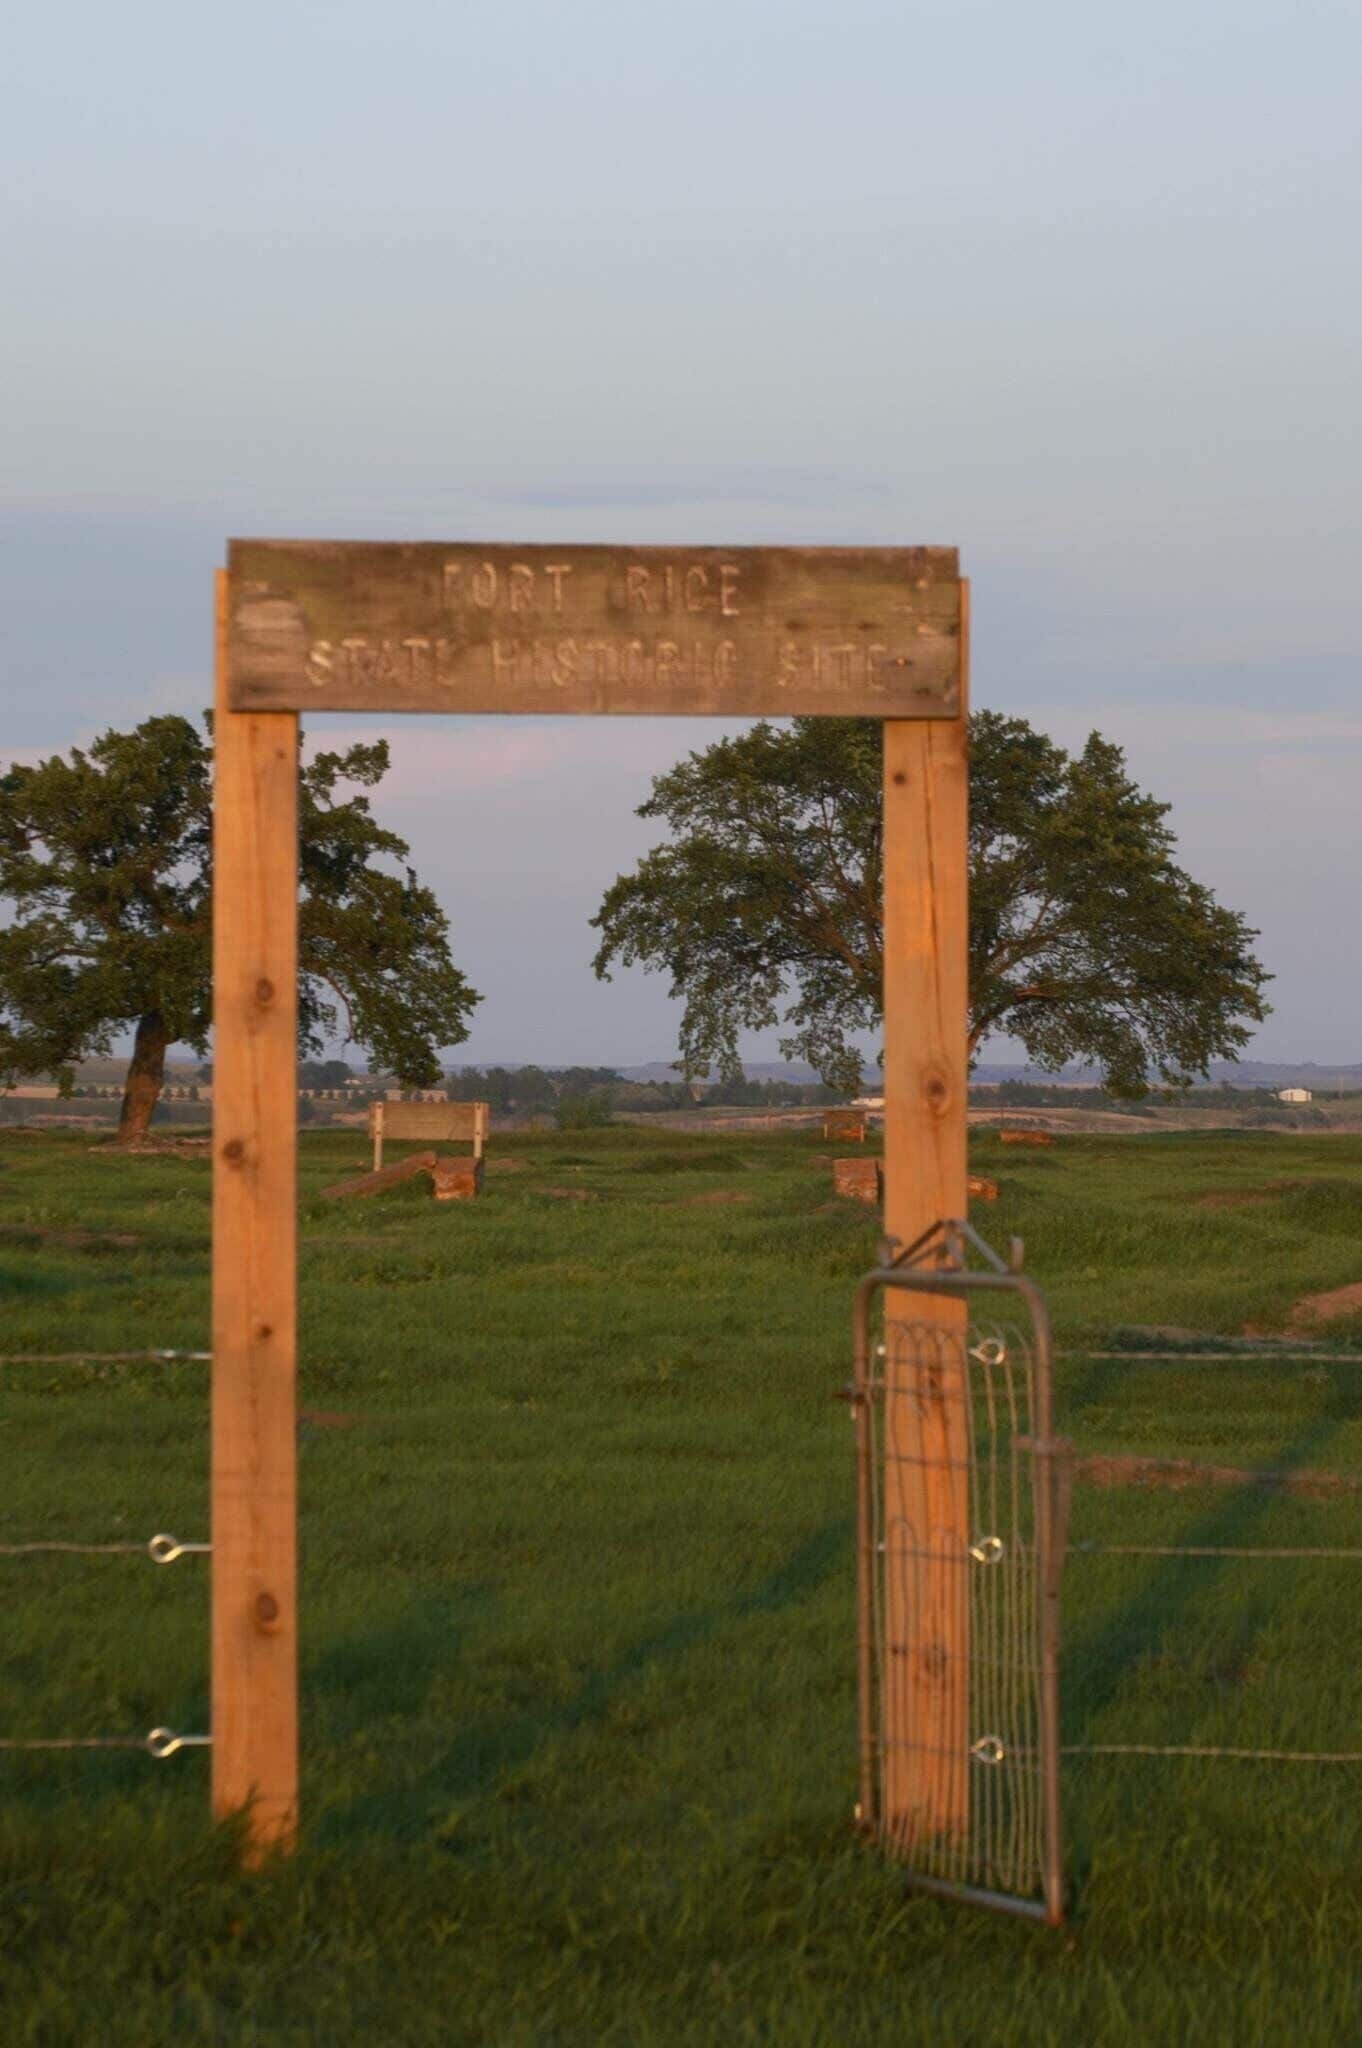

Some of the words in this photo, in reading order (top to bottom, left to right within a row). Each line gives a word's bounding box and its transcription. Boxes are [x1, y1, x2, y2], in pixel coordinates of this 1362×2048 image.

[442, 561, 573, 612] FORT
[625, 564, 741, 617] RICE
[304, 637, 457, 687] STATE
[491, 637, 738, 689] HISTORIC
[776, 640, 888, 690] SITE
